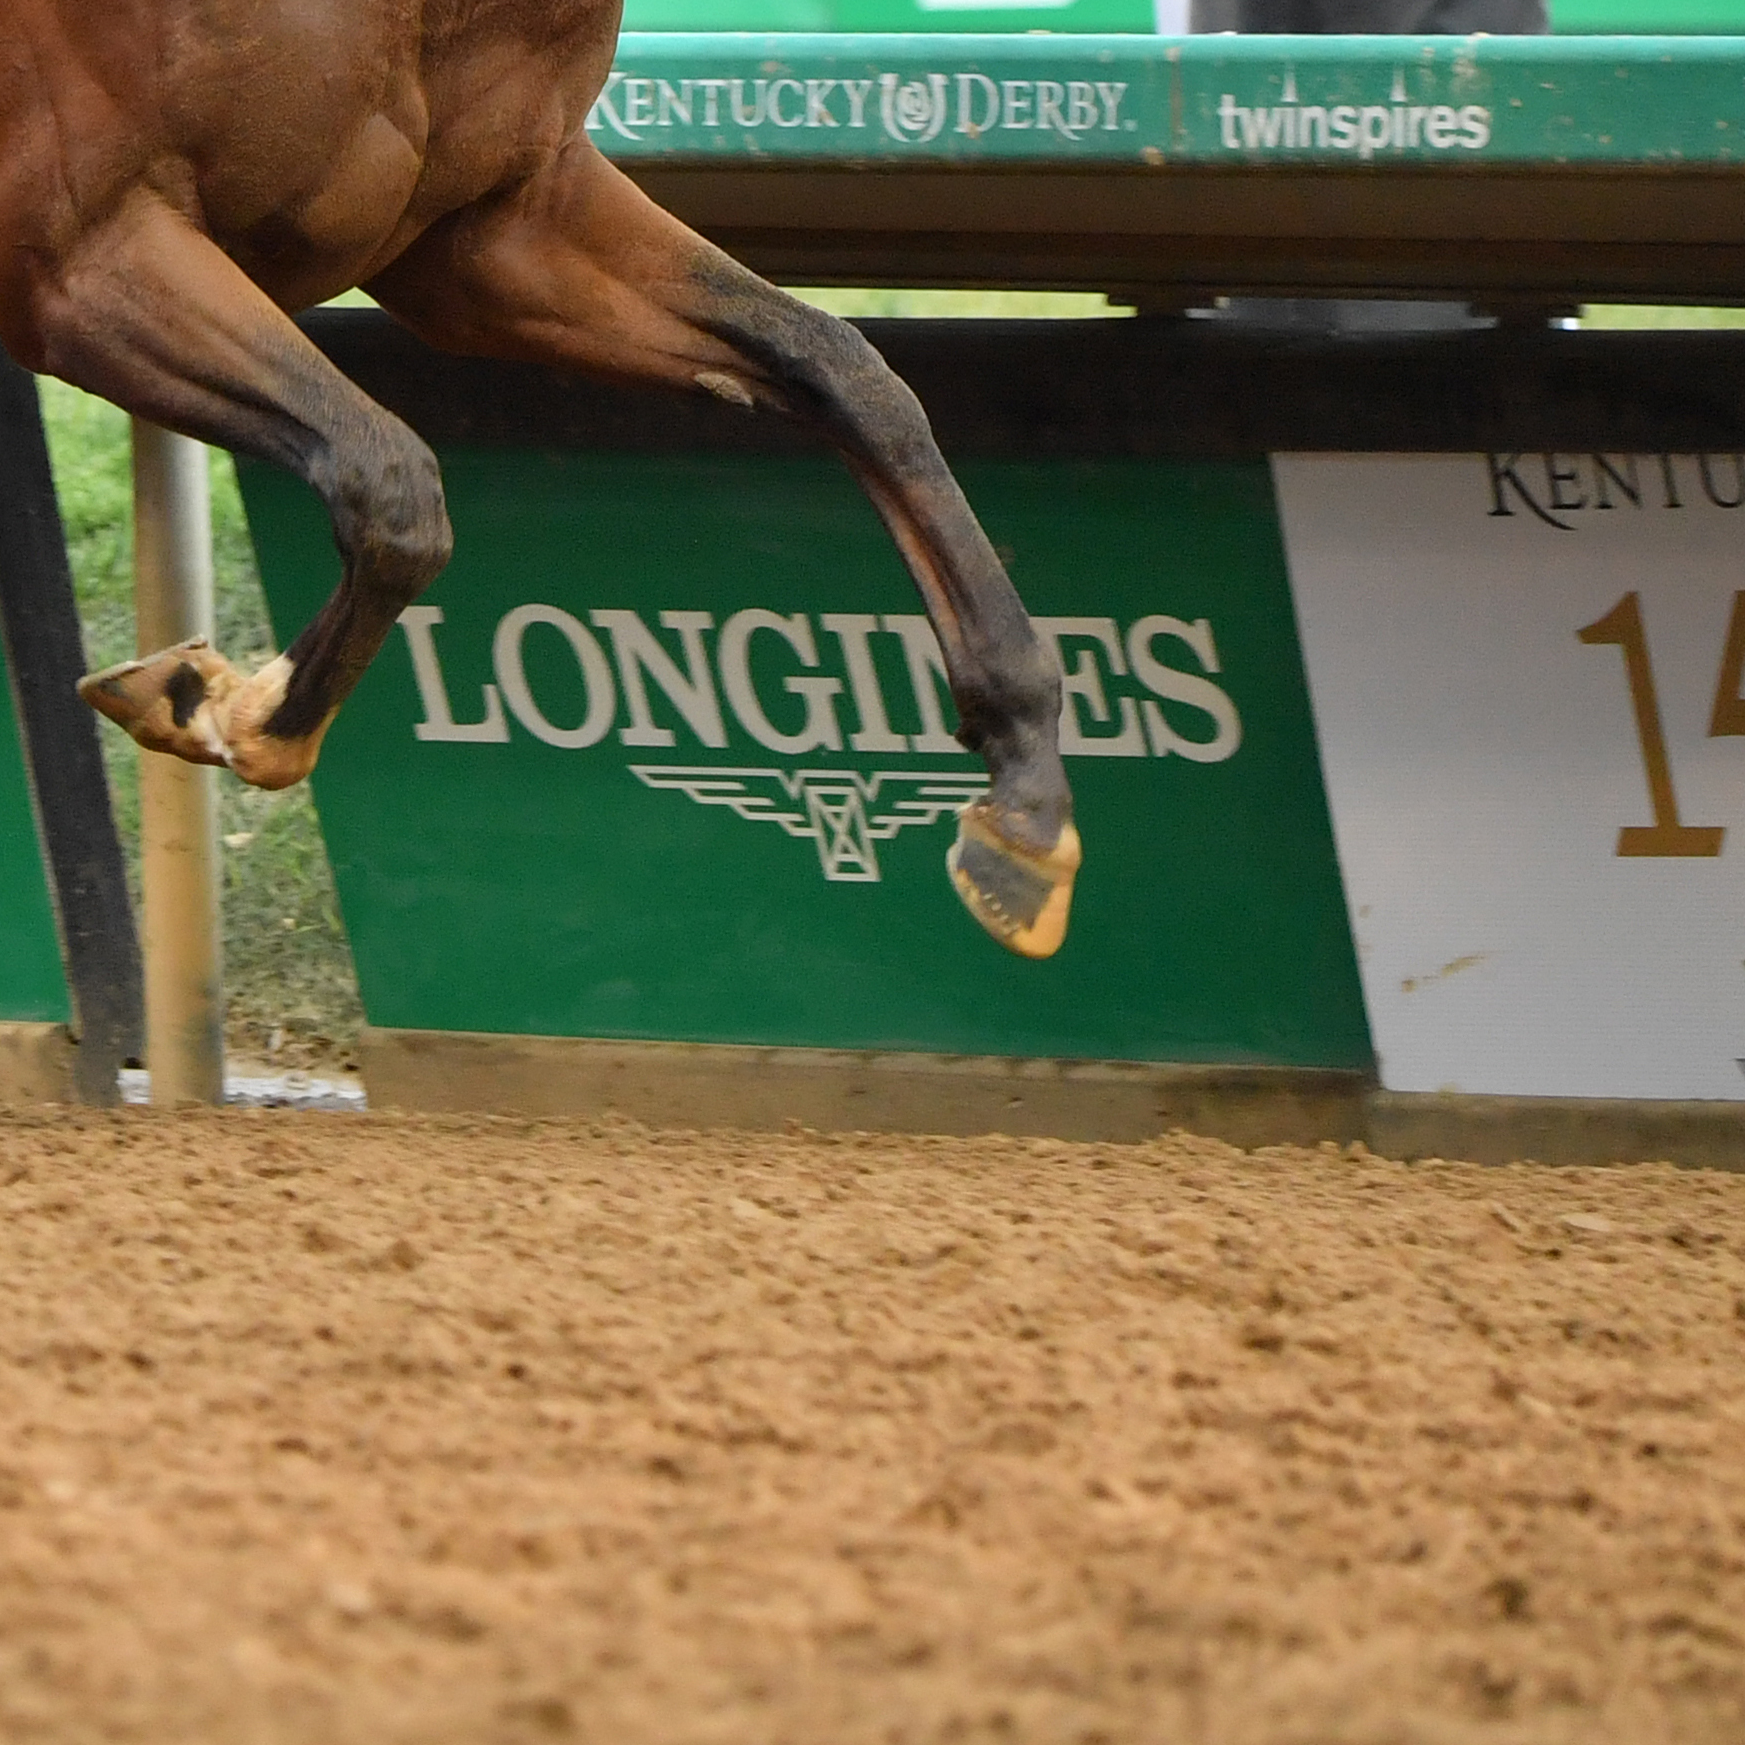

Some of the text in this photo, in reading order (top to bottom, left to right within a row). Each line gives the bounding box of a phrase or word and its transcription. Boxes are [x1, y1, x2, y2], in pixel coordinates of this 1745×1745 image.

[584, 71, 1130, 141] KENTUCKY DERBY
[1216, 58, 1493, 160] twinspires
